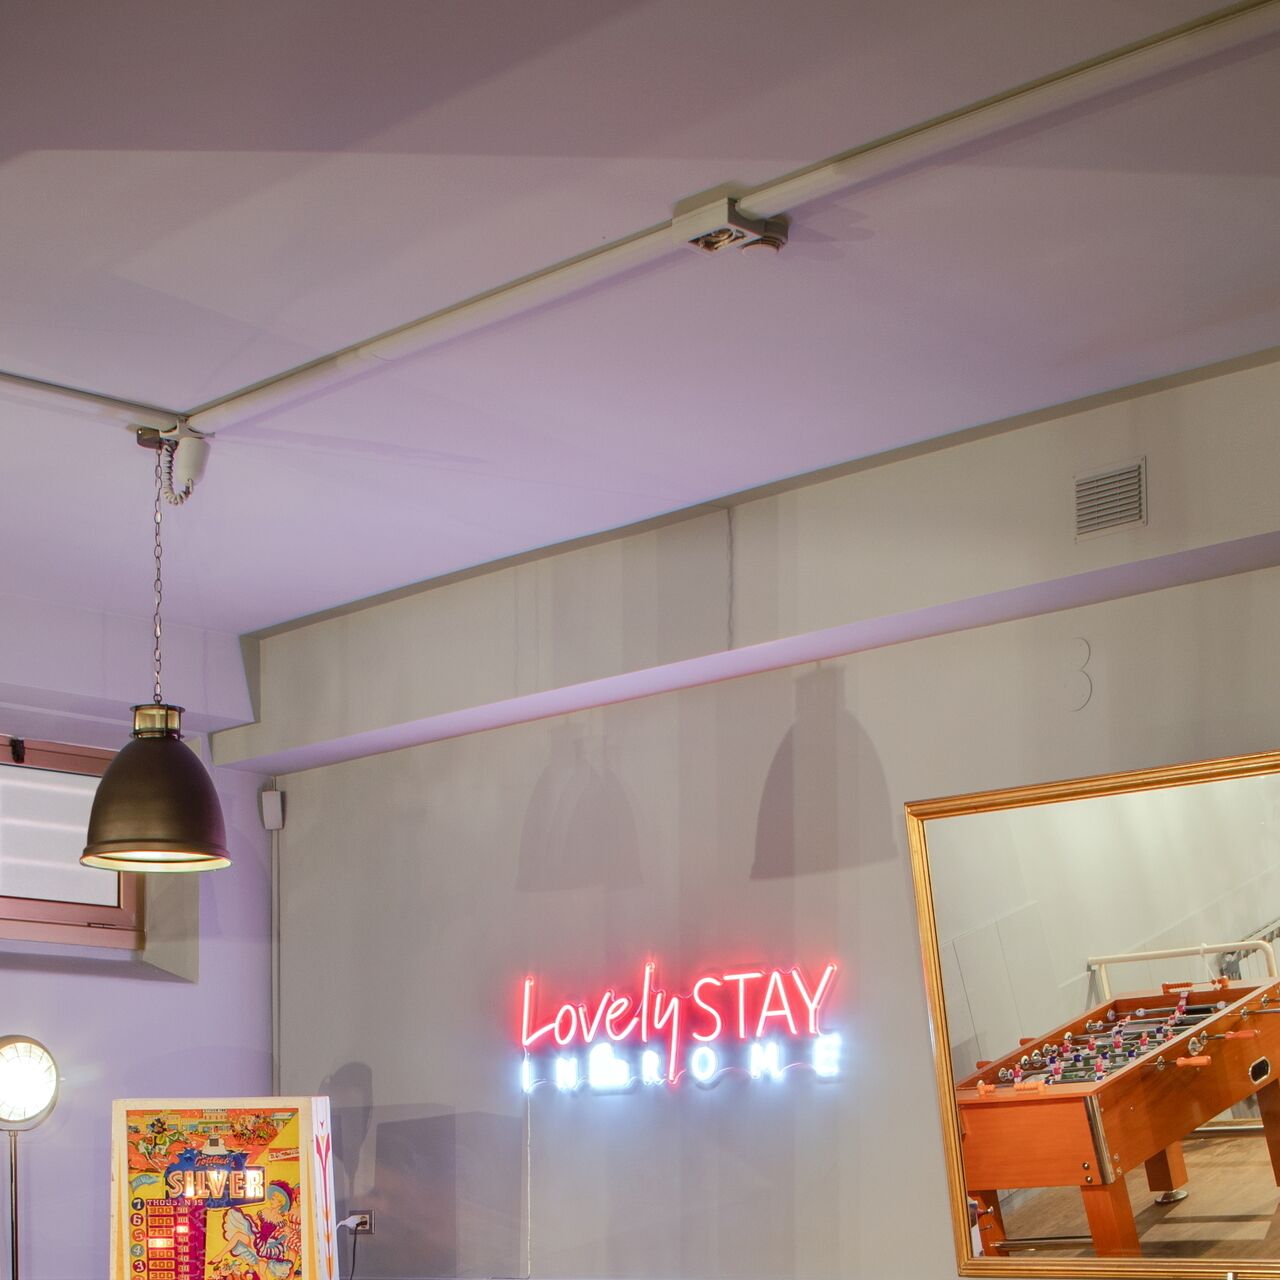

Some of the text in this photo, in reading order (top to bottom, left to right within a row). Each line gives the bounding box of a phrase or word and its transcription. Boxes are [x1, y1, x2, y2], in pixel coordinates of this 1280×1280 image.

[166, 1170, 265, 1199] SILVER
[134, 1199, 142, 1209] 7
[133, 1215, 141, 1225] 6
[135, 1231, 143, 1240] 5
[133, 1246, 141, 1256] 4
[135, 1261, 143, 1272] 3
